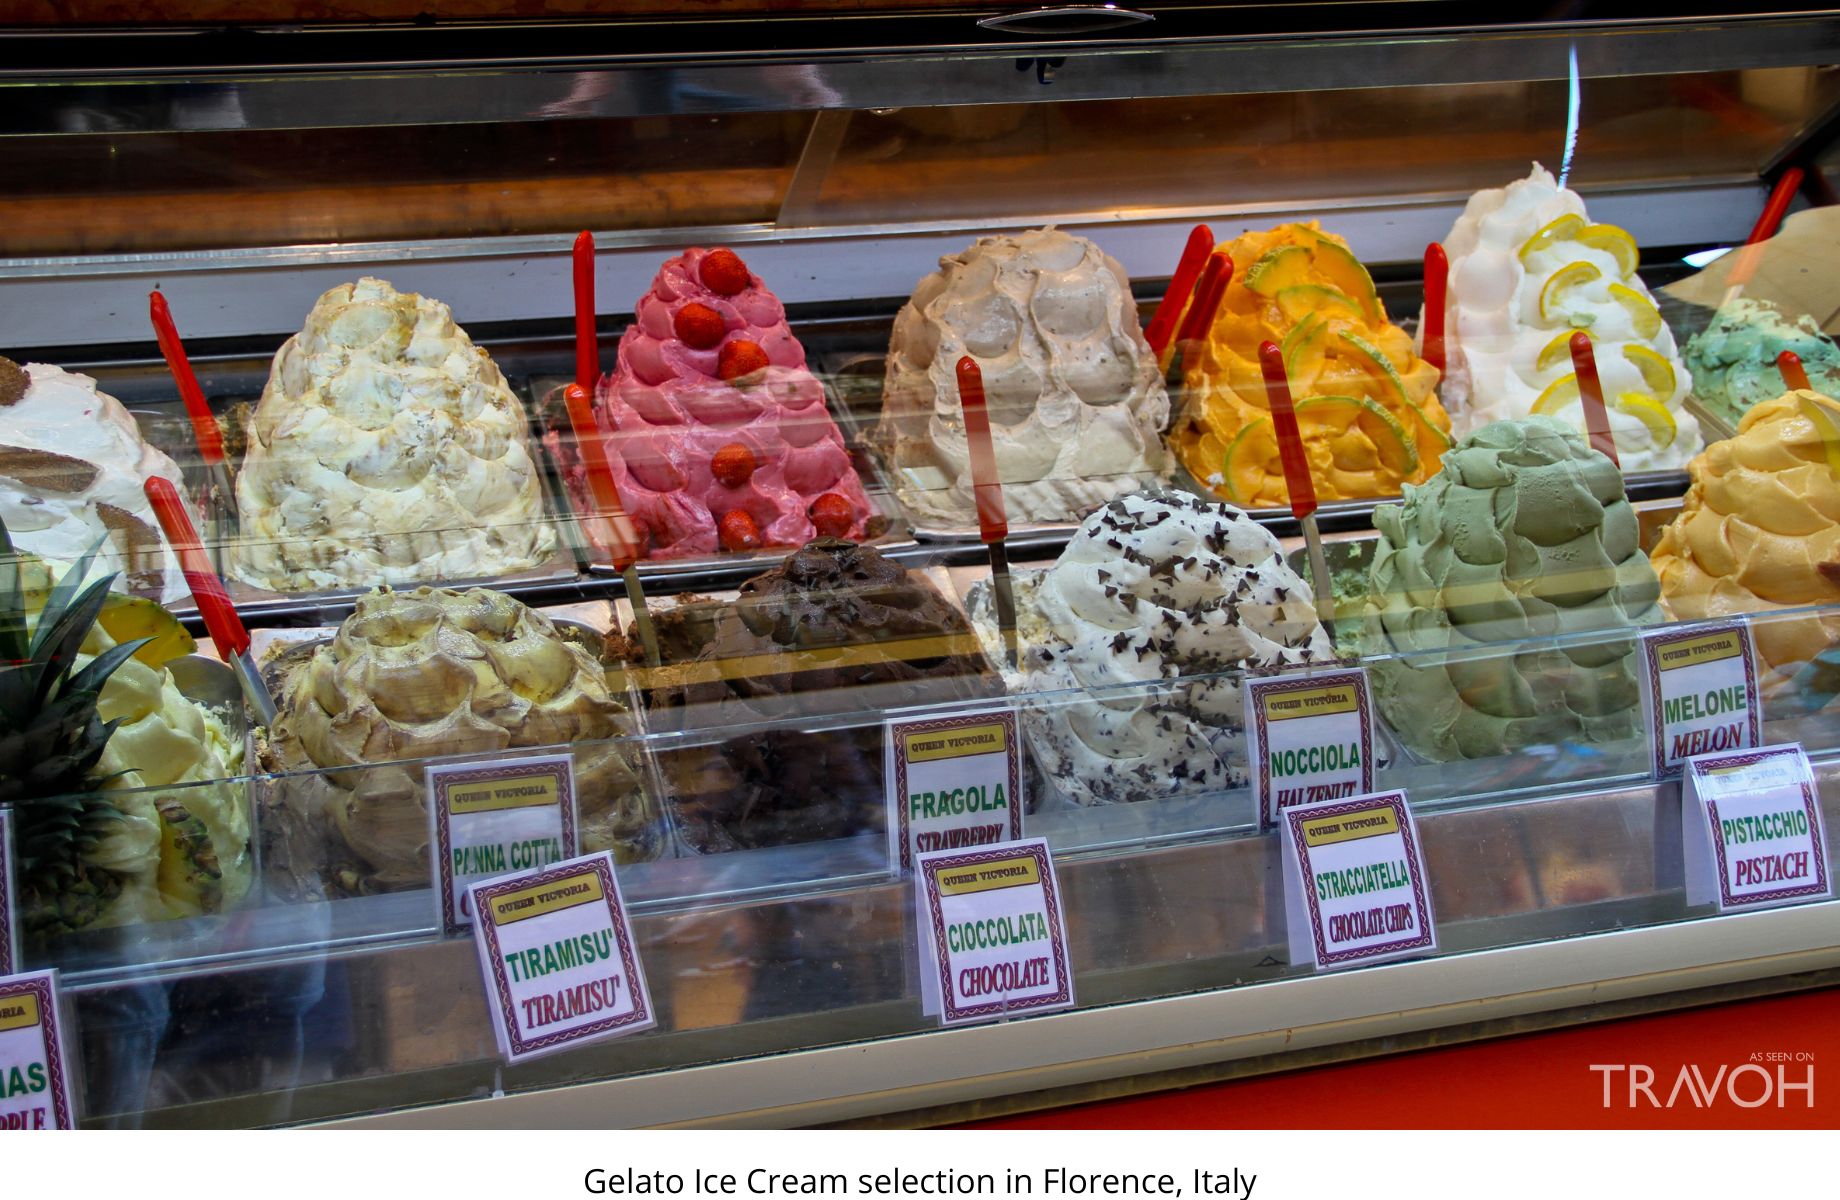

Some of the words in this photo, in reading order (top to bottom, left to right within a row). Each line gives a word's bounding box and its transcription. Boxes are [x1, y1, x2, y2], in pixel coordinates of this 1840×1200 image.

[1662, 648, 1690, 661] QUEEN
[1692, 640, 1732, 655] VICTORIA
[1270, 699, 1301, 711] QUEEN
[1304, 694, 1348, 706] VICTORIA
[1664, 685, 1747, 724] MELONE
[911, 740, 945, 752] QUEEN
[948, 734, 996, 747] VICTORIA
[1670, 722, 1744, 760] MELON
[1271, 743, 1360, 777] NOCCIOLA
[454, 790, 491, 803] QUEEN
[495, 785, 548, 799] VICTORIA
[910, 783, 1007, 820] FRAGOLA
[1309, 824, 1341, 837] QUEEN
[1342, 816, 1388, 831] VICTORIA
[1722, 810, 1808, 845] PISTACCHIO
[454, 843, 506, 875] PANNA
[511, 838, 561, 870] COTTA
[1735, 851, 1809, 886] PISTACH
[943, 873, 978, 886] QUEEN
[979, 866, 1029, 880] VICTORIA
[1316, 860, 1410, 901] STRACCIATELLA
[498, 896, 535, 914] QUEEN
[537, 883, 591, 903] VICTORIA
[949, 912, 1048, 953] CIOCCOLATA
[1329, 907, 1385, 943] CHOCOLATE
[1385, 902, 1413, 934] CHIPS
[505, 928, 613, 982] TIRAMISU'
[959, 957, 1049, 998] CHOCOLATE
[0, 1006, 26, 1019] RIA
[522, 974, 620, 1029] TIRAMISU'
